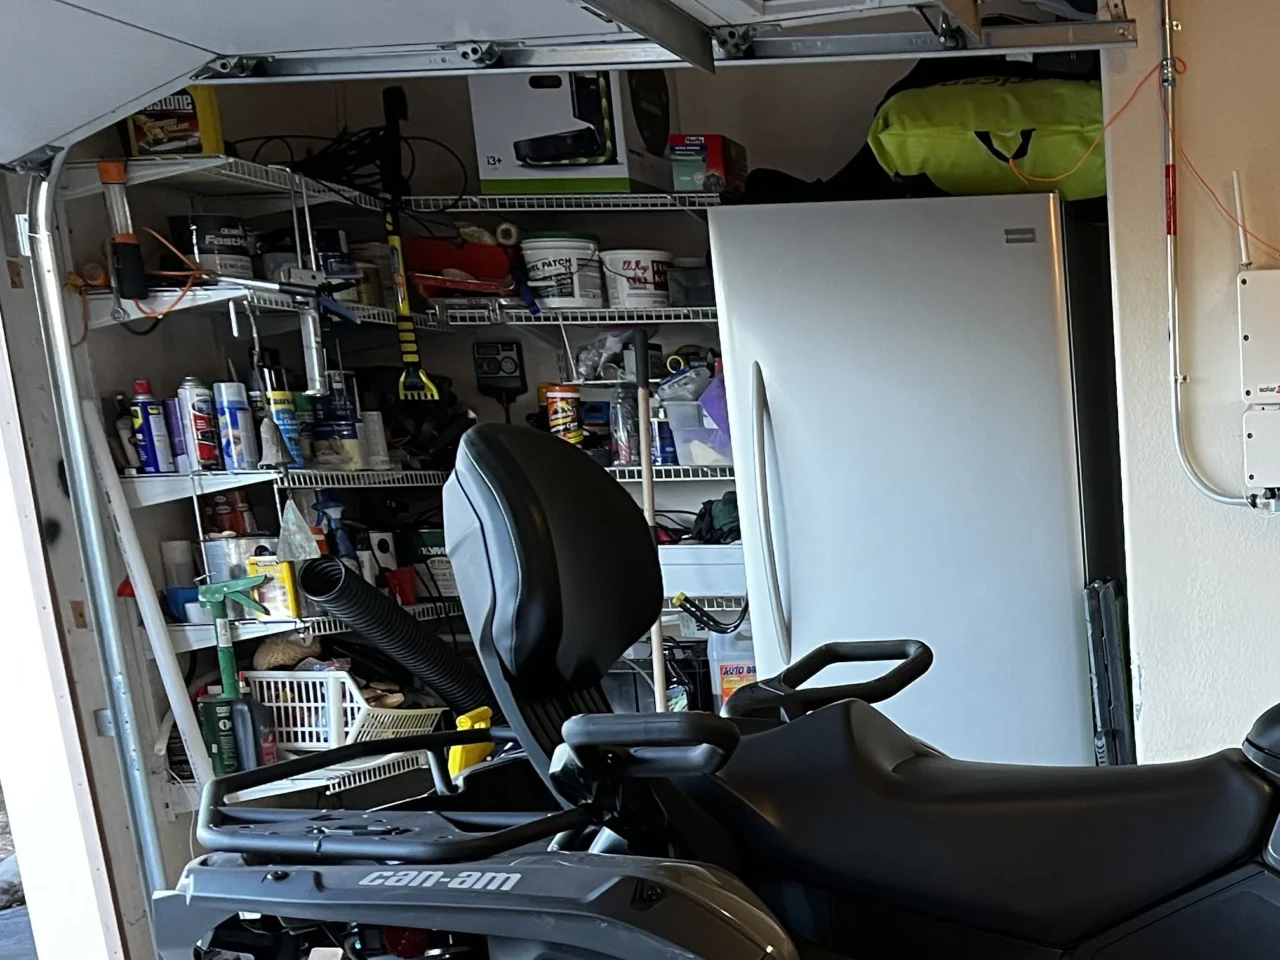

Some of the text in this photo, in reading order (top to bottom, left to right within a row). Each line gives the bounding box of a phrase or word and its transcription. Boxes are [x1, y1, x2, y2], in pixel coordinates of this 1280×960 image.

[542, 257, 573, 270] PATCH
[723, 665, 745, 676] AUTO
[358, 870, 522, 891] can-am
